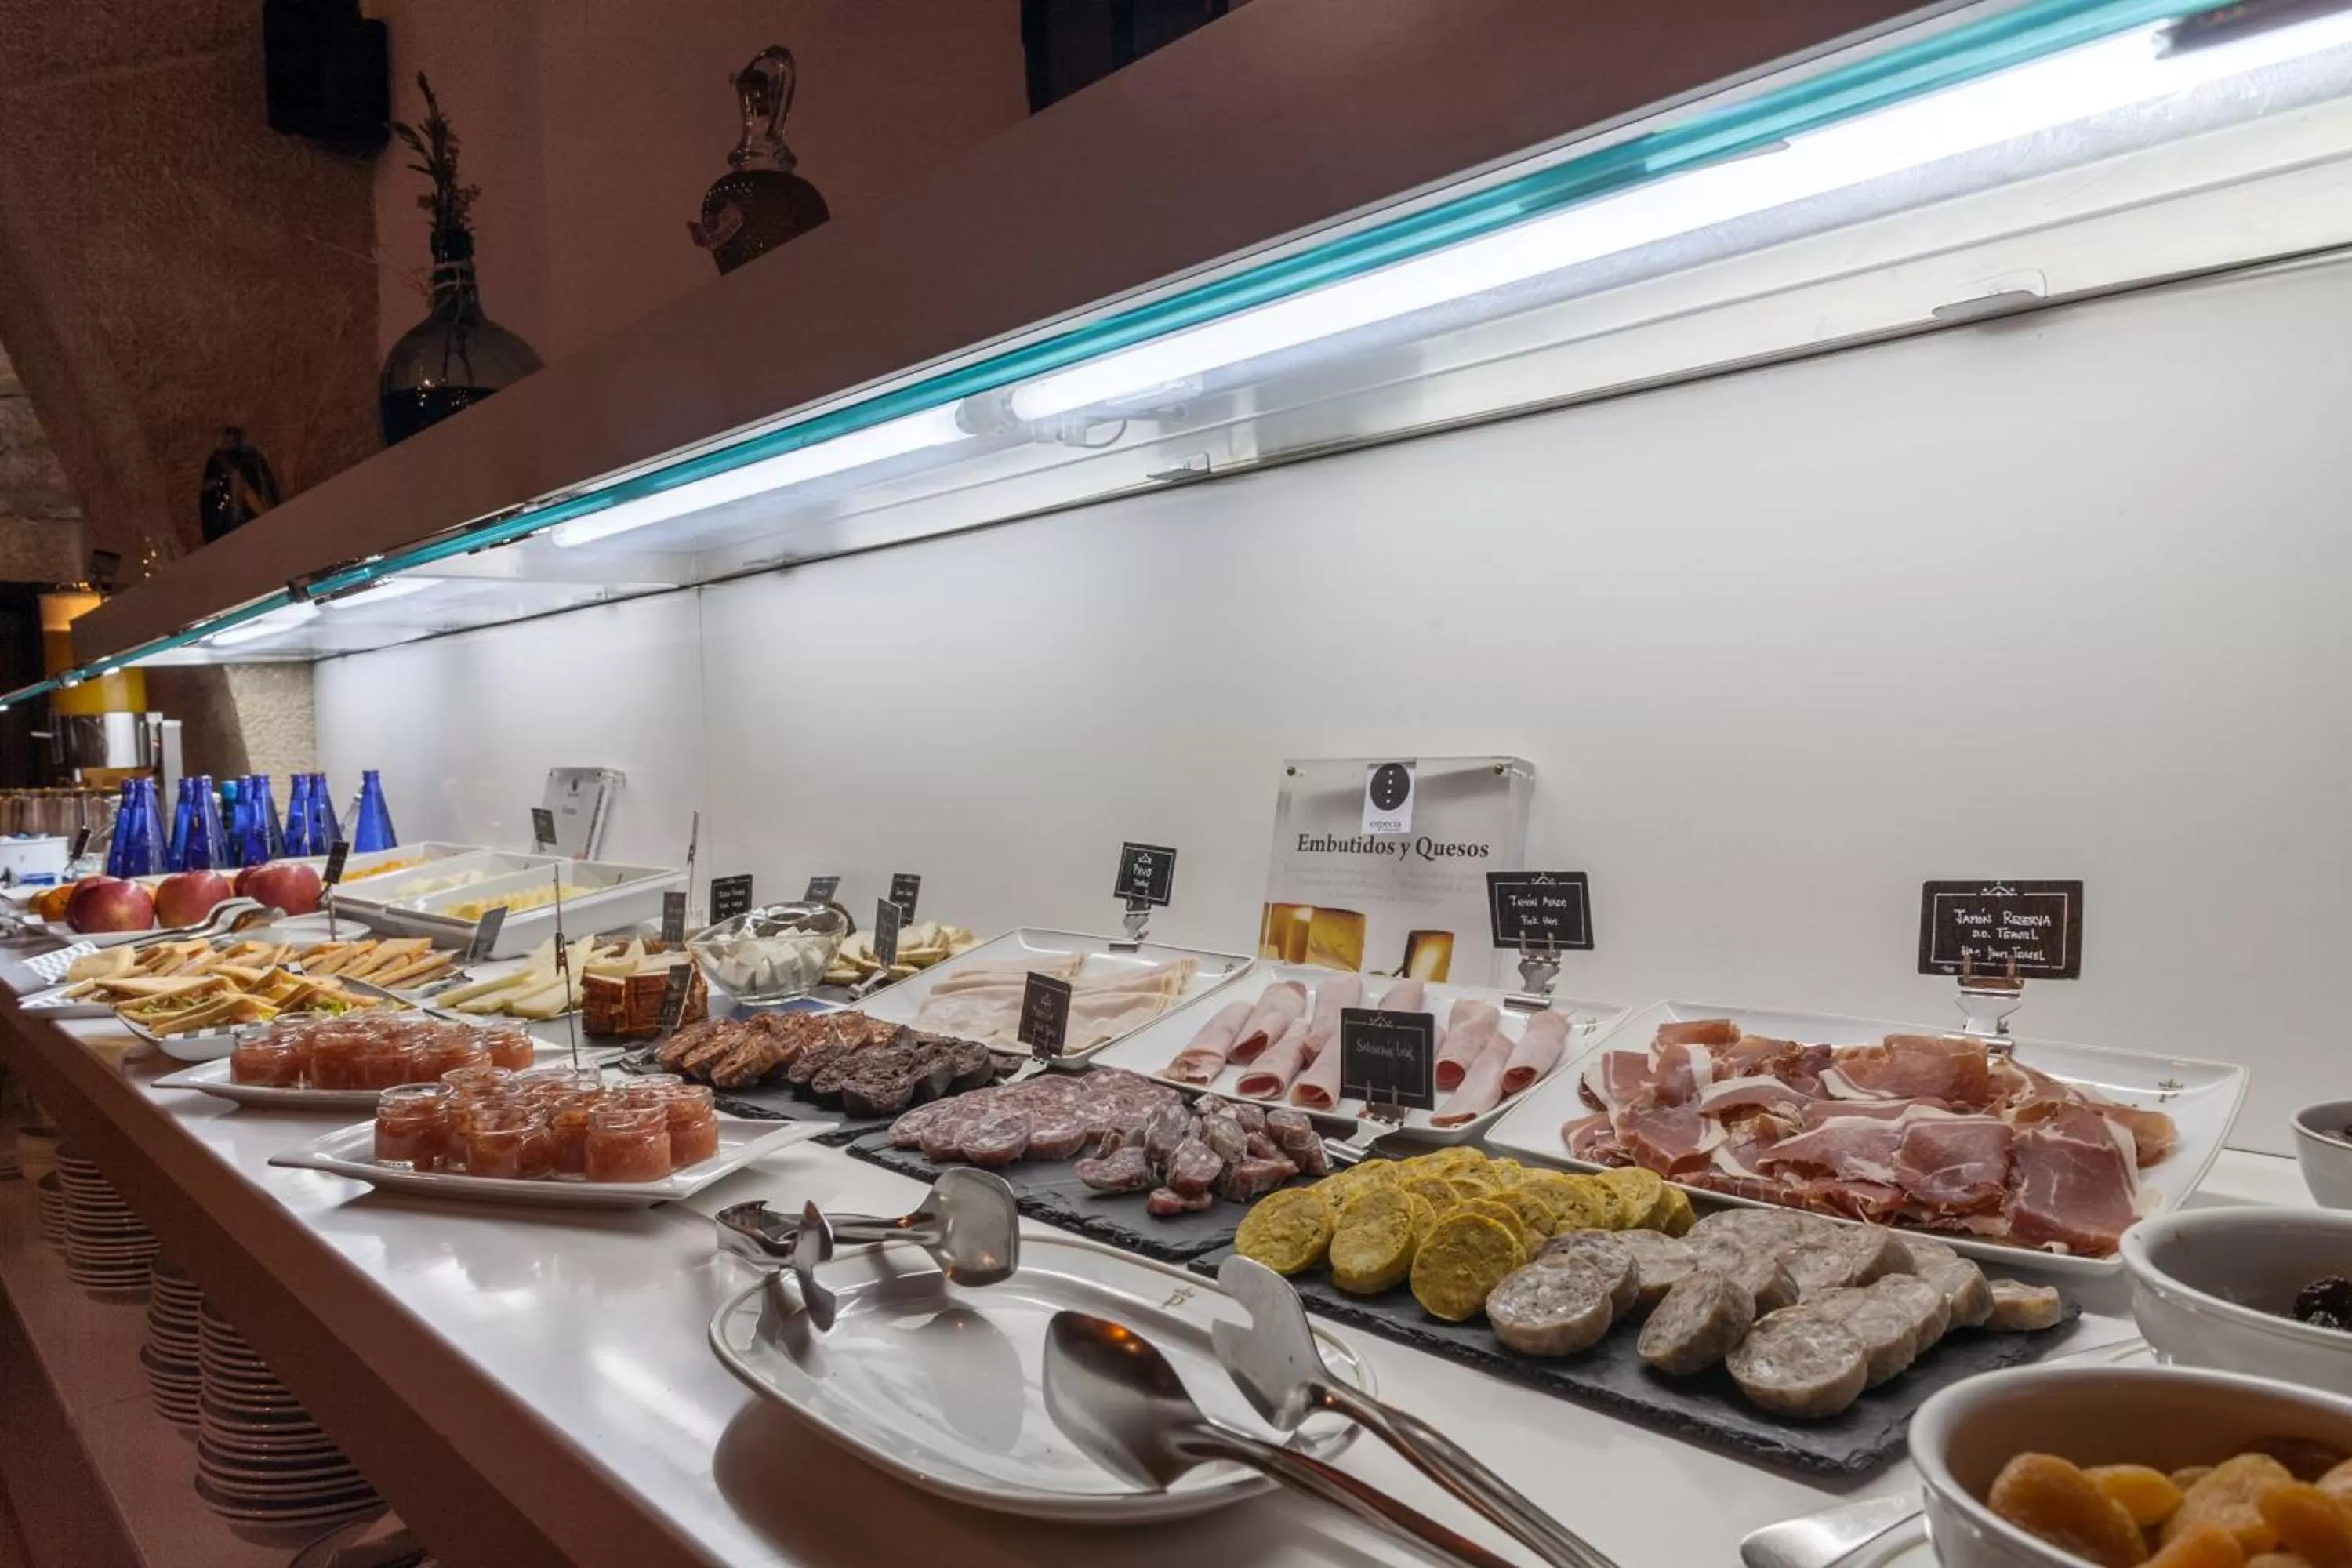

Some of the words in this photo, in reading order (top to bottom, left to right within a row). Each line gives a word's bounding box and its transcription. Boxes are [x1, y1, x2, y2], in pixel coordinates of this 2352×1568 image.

[1297, 833, 1396, 855] Embutidos
[1399, 841, 1411, 861] y
[1415, 837, 1490, 861] Quesos
